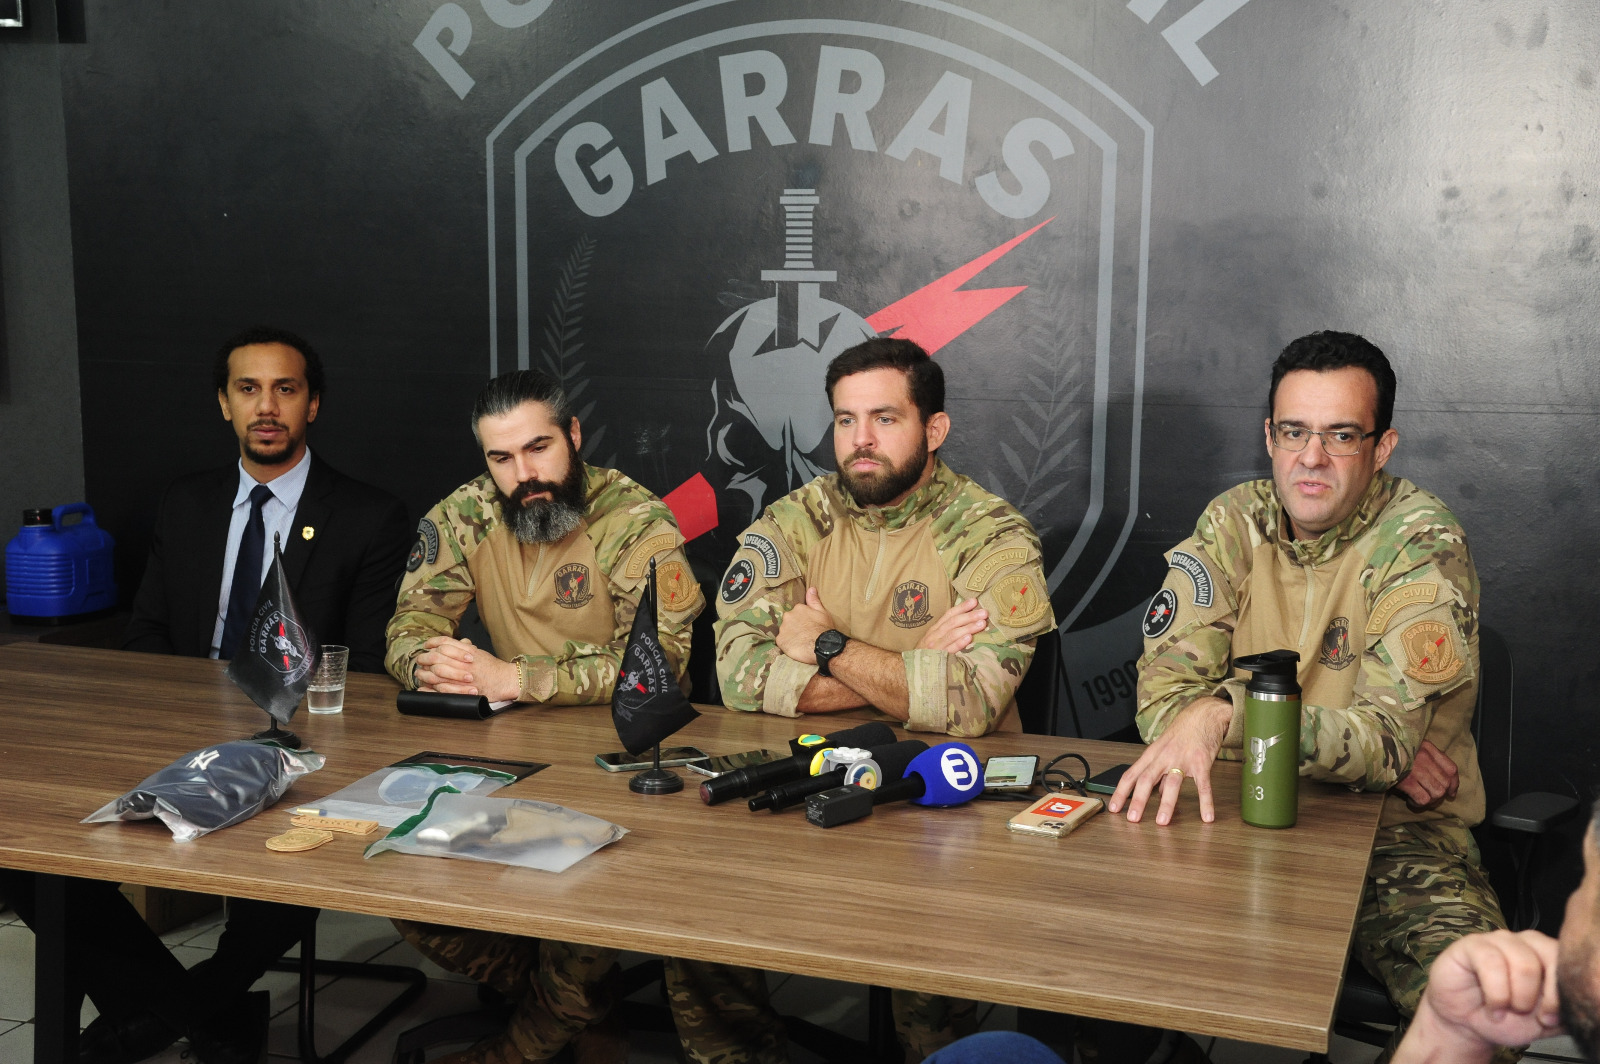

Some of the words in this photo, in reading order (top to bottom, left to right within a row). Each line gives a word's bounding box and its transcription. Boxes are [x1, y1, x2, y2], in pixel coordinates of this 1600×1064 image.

[554, 45, 1075, 219] GARRAS
[650, 538, 672, 547] CIVIL
[1000, 552, 1024, 561] CIVIL
[557, 565, 585, 577] GARRAS
[995, 576, 1028, 593] GARRAS
[1402, 588, 1432, 598] CIVIL
[260, 613, 280, 653] GARRAS
[1406, 624, 1447, 640] GARRAS
[634, 646, 656, 693] GARRAS
[659, 668, 668, 693] CIVIL
